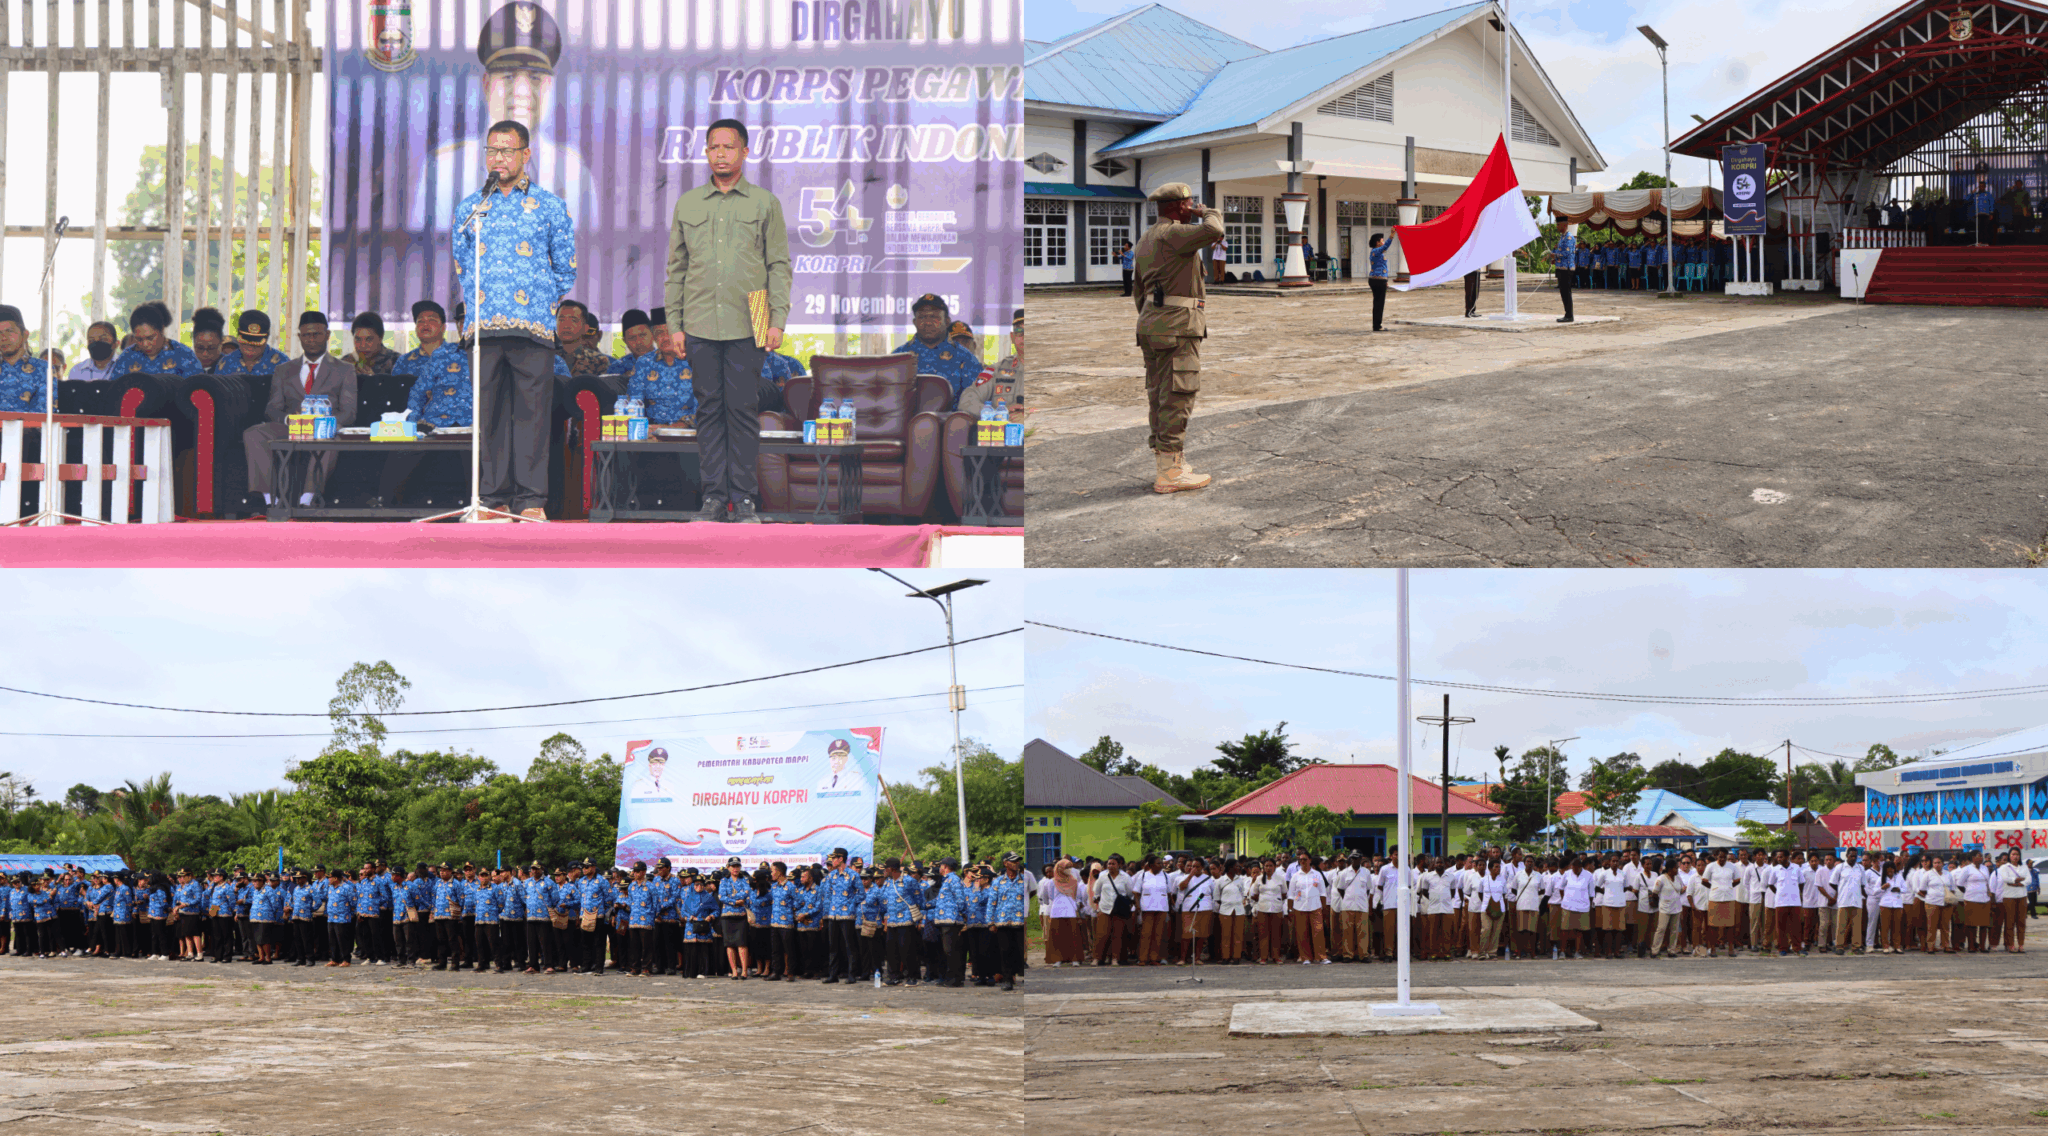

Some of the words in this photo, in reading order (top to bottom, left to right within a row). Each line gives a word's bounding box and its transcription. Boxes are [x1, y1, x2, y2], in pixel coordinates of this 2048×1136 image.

[792, 0, 964, 41] DIRGAHAYU
[711, 66, 854, 102] KORPS
[858, 65, 1024, 102] PEGAW
[660, 126, 876, 162] REUBLIK
[877, 124, 1024, 162] INDON
[794, 255, 873, 273] KORPRI
[805, 294, 826, 315] 29
[830, 294, 914, 315] November
[785, 755, 809, 764] MAPPI
[692, 791, 760, 806] DIRGAHAYU
[763, 788, 808, 804] KORPRI
